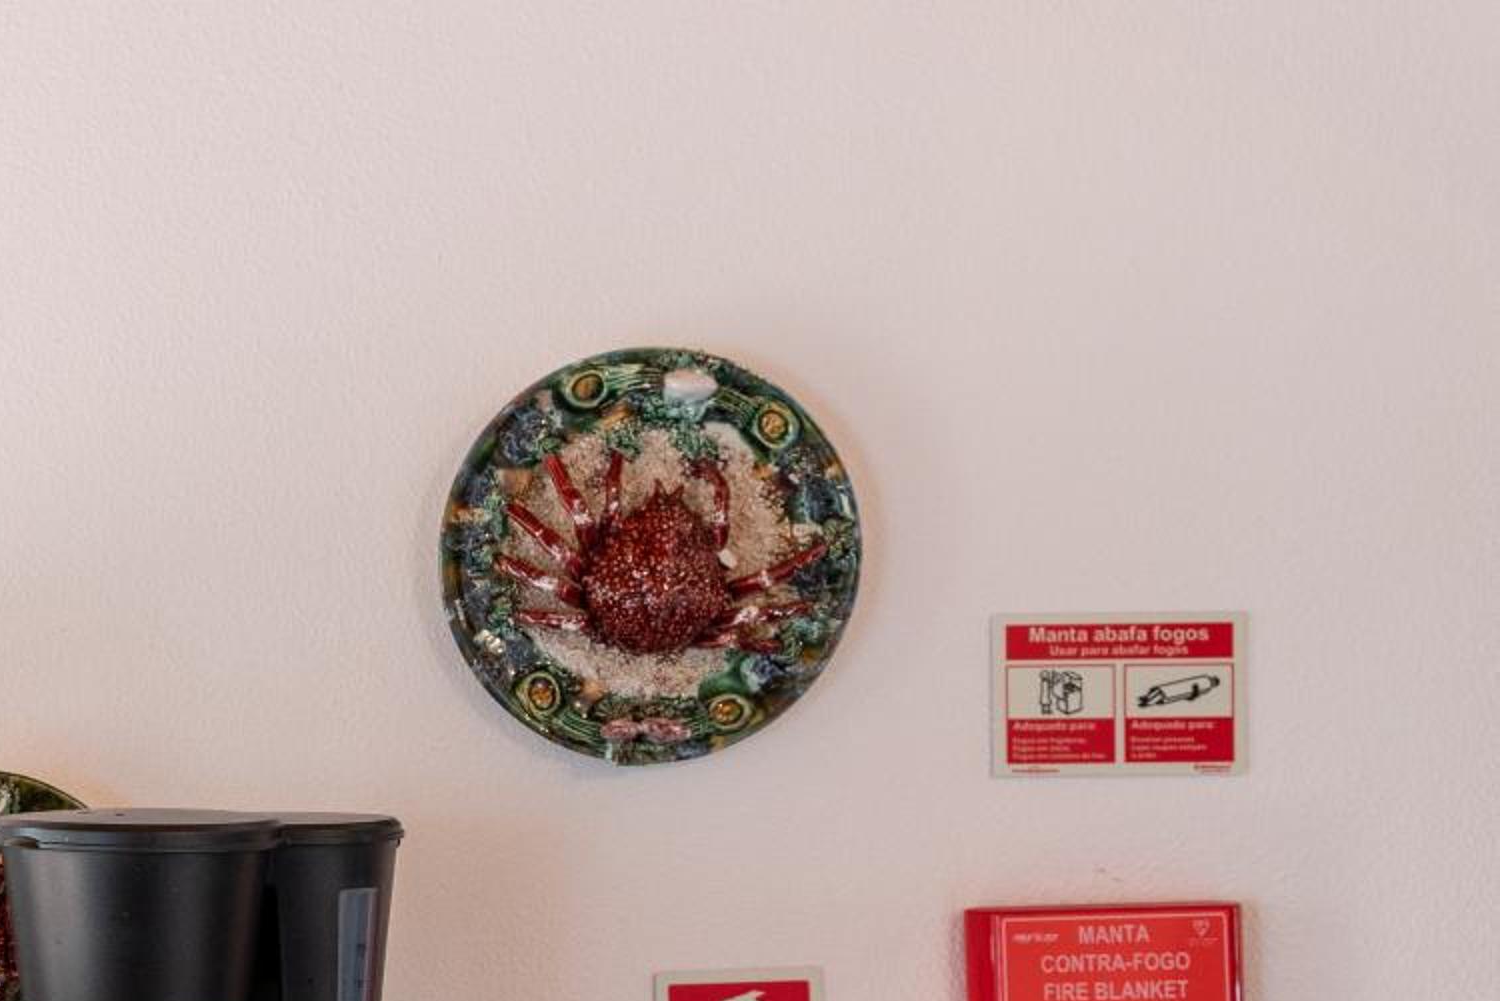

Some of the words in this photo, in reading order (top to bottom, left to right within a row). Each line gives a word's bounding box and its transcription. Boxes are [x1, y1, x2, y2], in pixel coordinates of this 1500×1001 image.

[1028, 626, 1088, 643] Manta
[1093, 624, 1148, 642] abafa
[1153, 624, 1210, 646] fogos
[1049, 645, 1077, 657] Usar
[1081, 646, 1109, 658] para
[1078, 924, 1150, 945] MANTA
[1040, 951, 1191, 975] CONTRA-FOGO
[1043, 982, 1089, 1001] FIRE
[1094, 979, 1189, 1001] BLANKET
